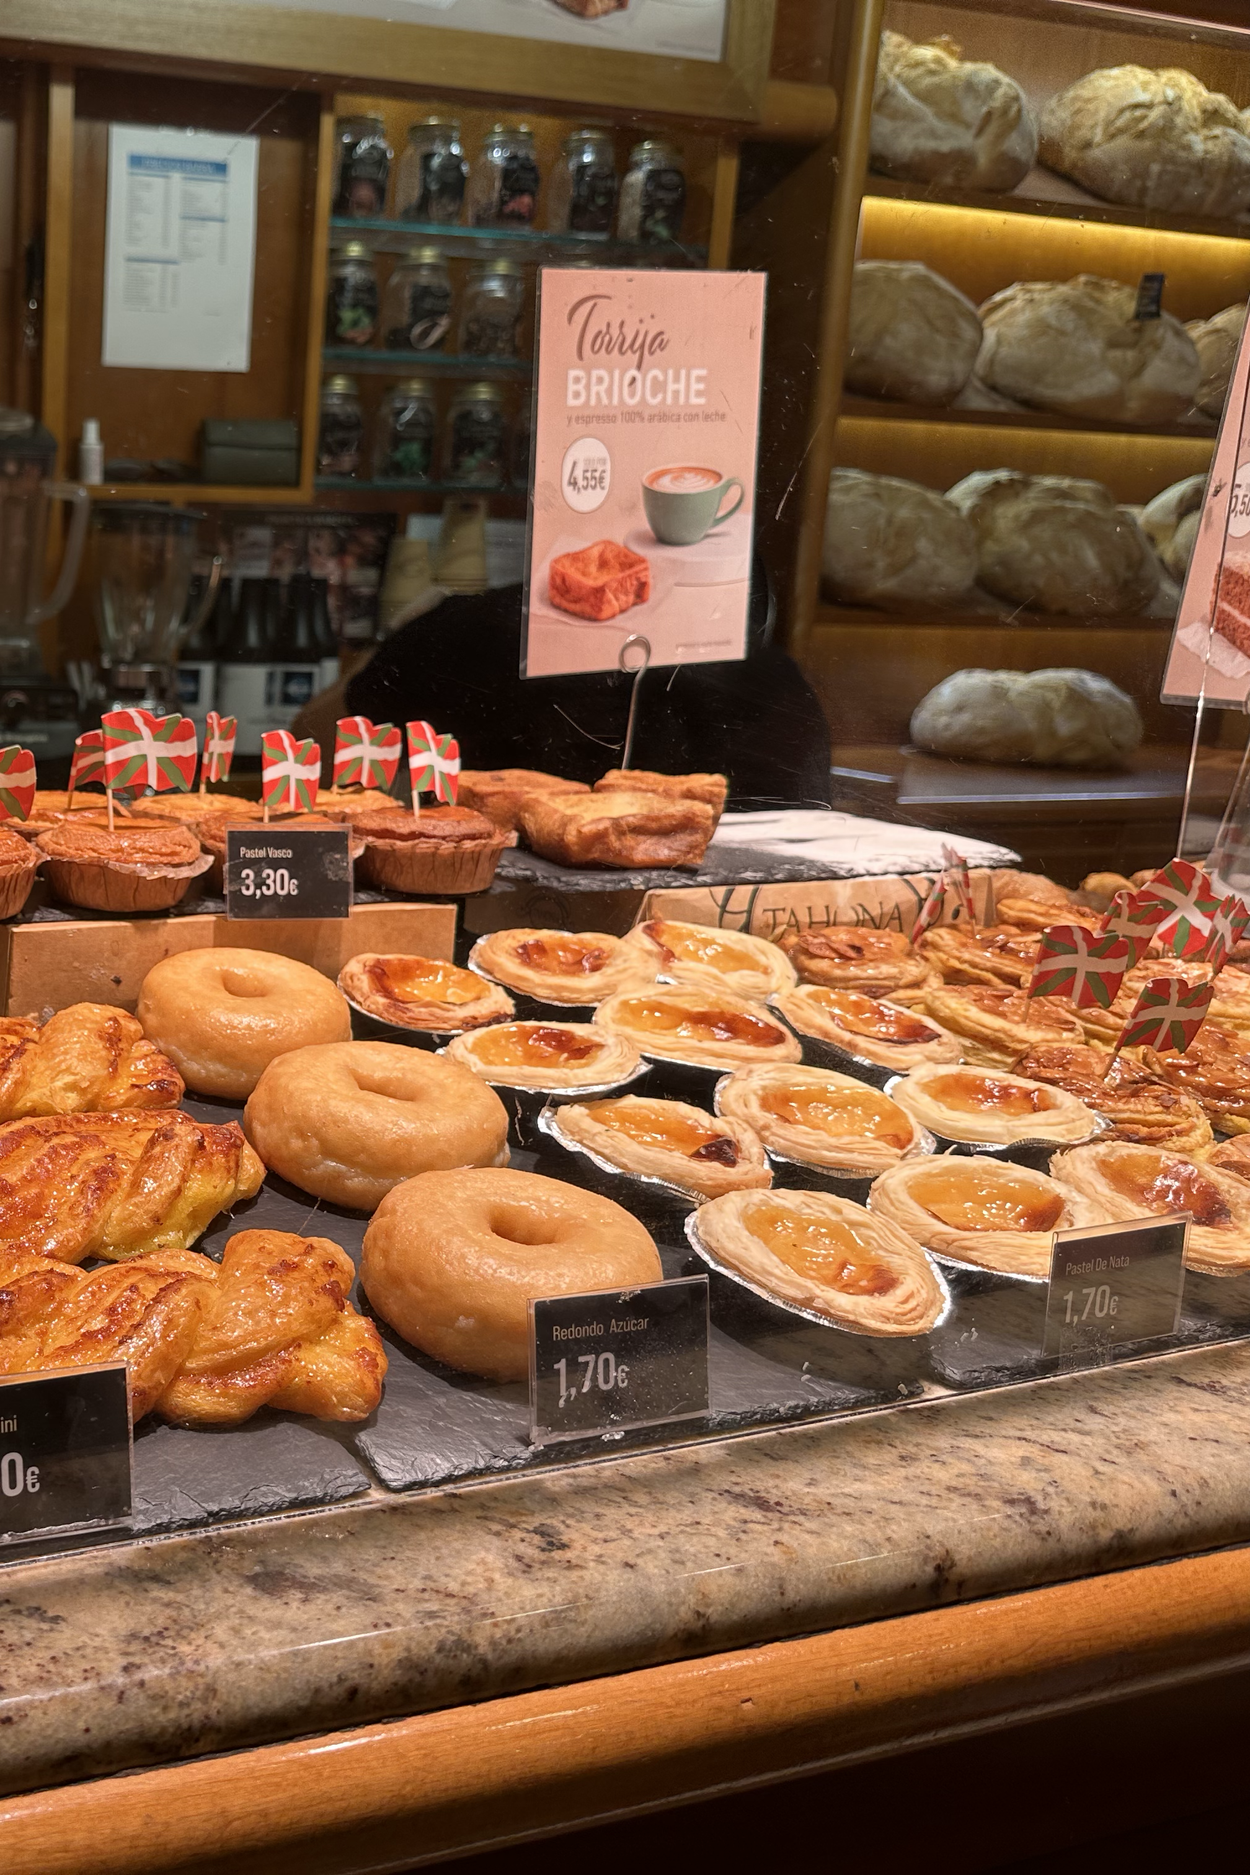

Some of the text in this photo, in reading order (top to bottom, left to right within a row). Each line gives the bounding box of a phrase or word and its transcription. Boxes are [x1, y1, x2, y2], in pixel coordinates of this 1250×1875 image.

[566, 294, 670, 387] Torrija
[566, 368, 708, 407] BRIOCHE
[566, 410, 726, 427] y espresso 100% arábica con leche
[567, 460, 607, 493] 4,55€
[240, 847, 293, 858] Pastel Vasco
[240, 868, 299, 899] 3,30€
[1066, 1255, 1130, 1276] Pastel De Nata
[1063, 1285, 1119, 1327] 1,70€
[552, 1317, 649, 1341] Redondo Azúcar
[553, 1352, 629, 1402] 1,70€
